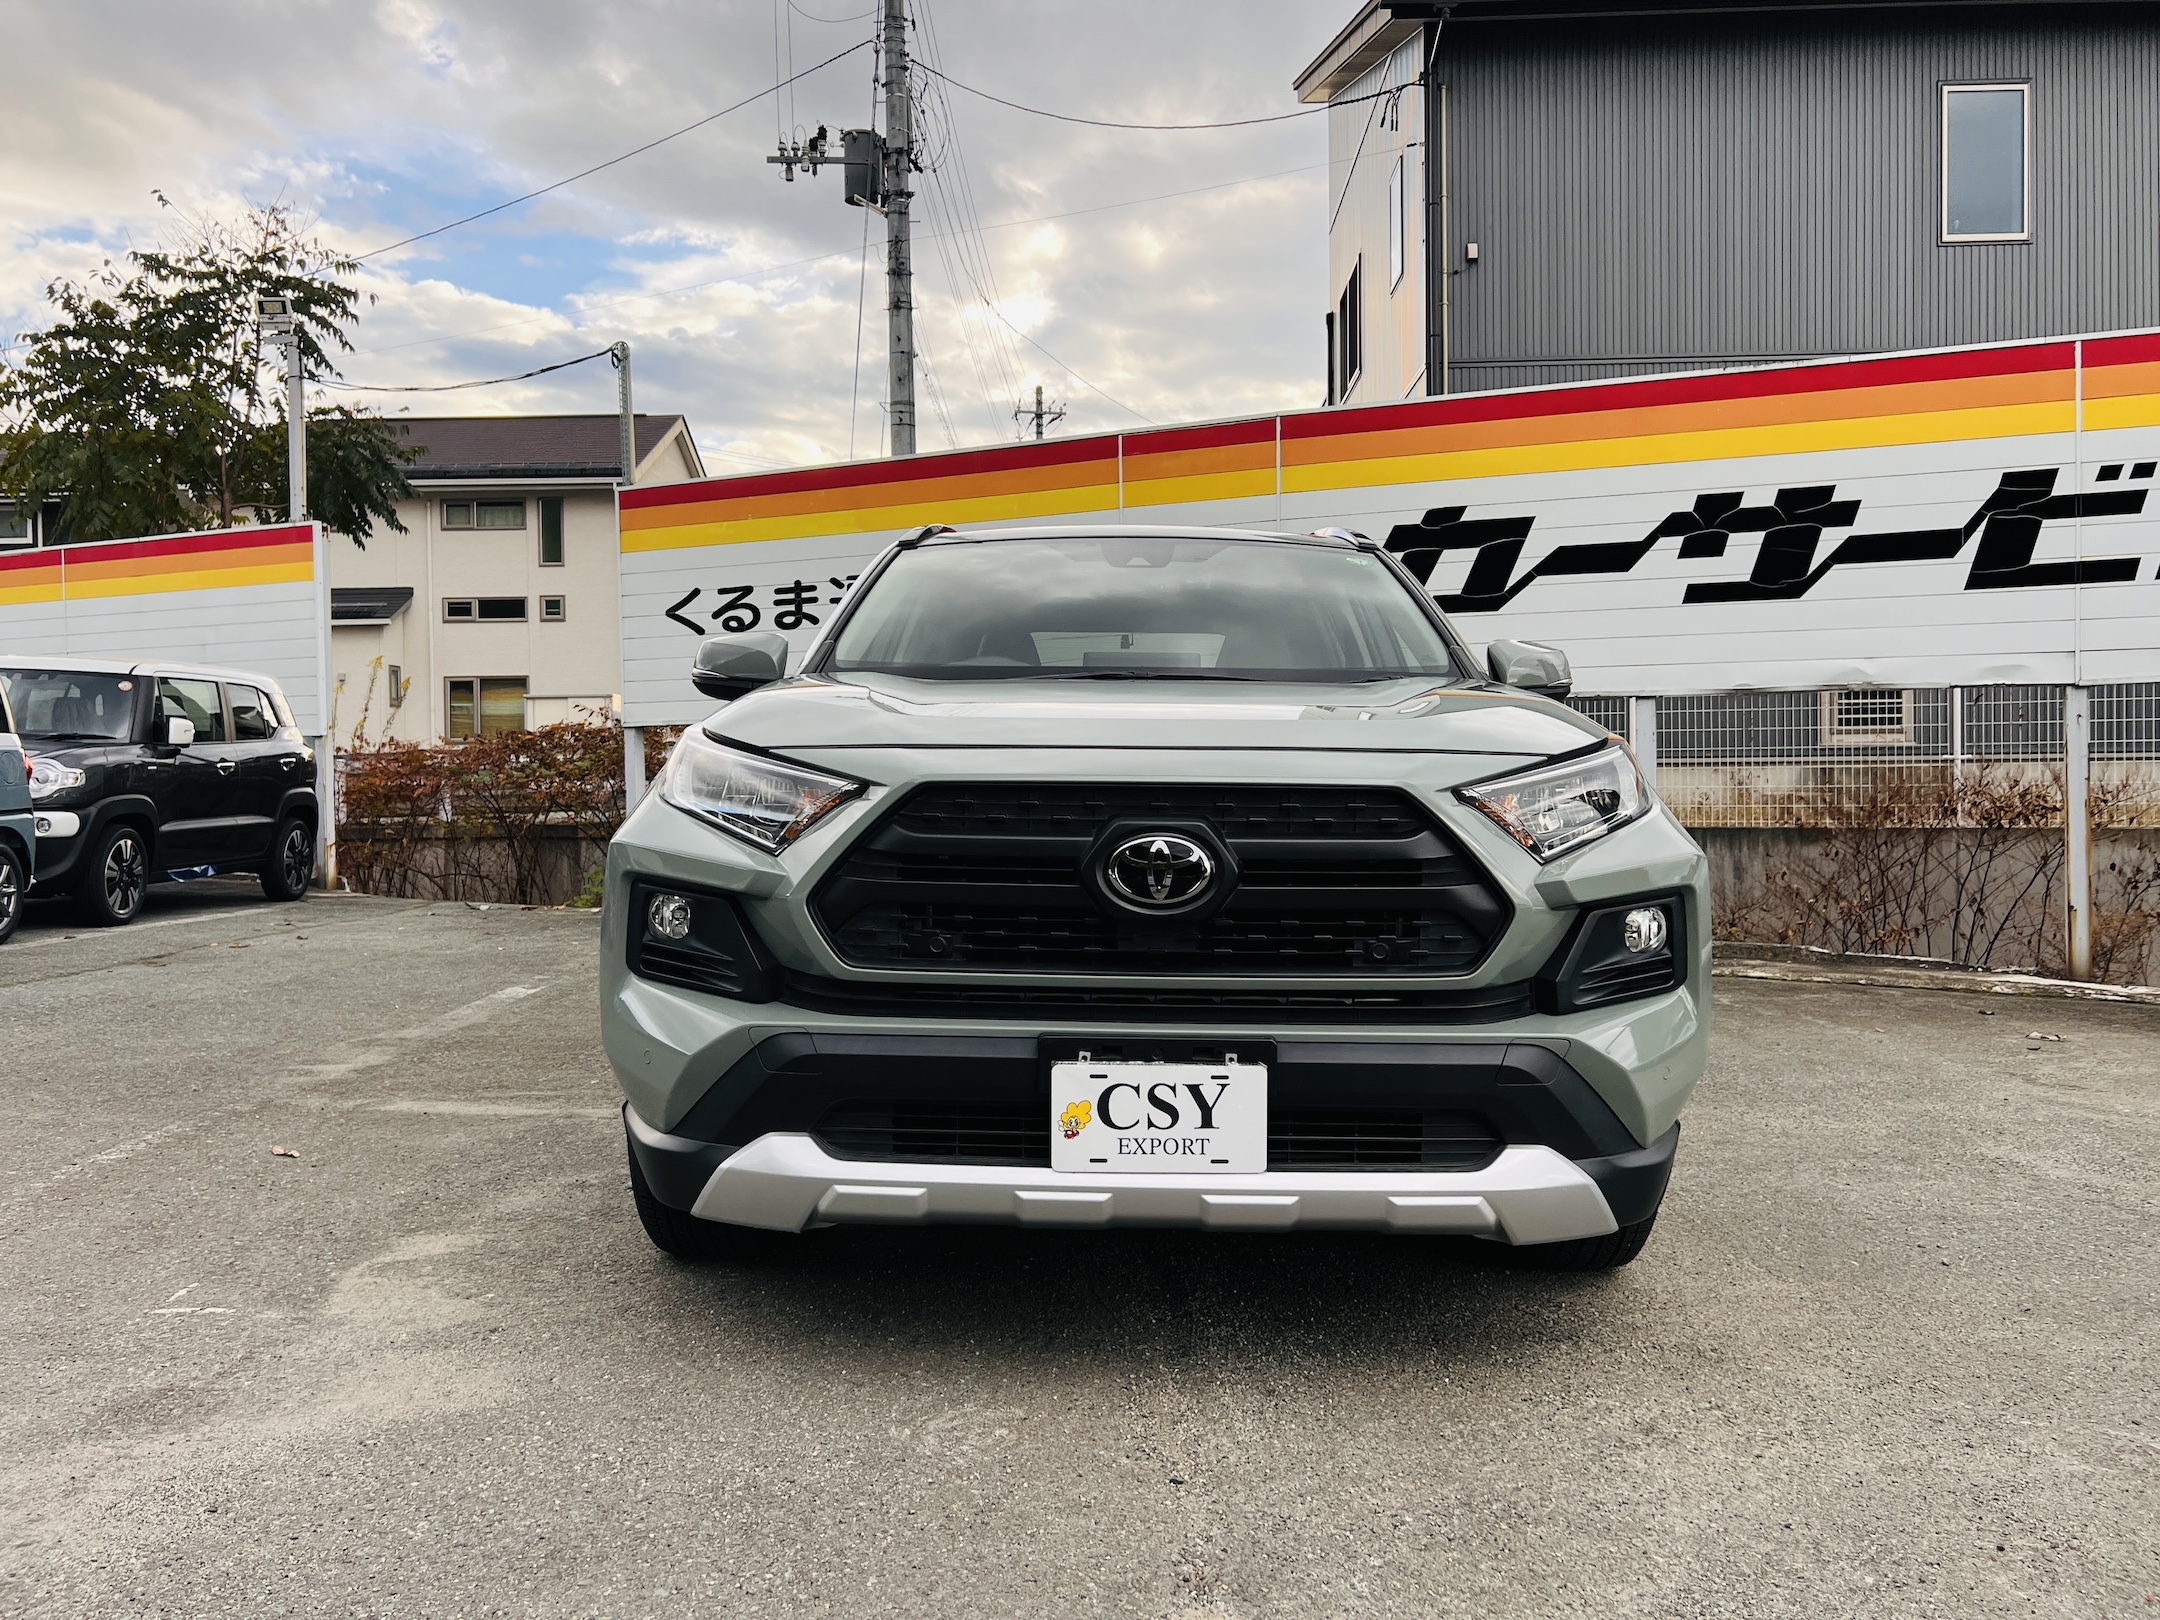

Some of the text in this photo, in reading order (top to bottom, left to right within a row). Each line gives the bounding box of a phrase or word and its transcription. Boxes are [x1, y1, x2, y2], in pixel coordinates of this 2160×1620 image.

[1382, 461, 2160, 613] カーサービ
[1096, 1082, 1230, 1131] CSY
[1117, 1137, 1210, 1155] EXPORT
